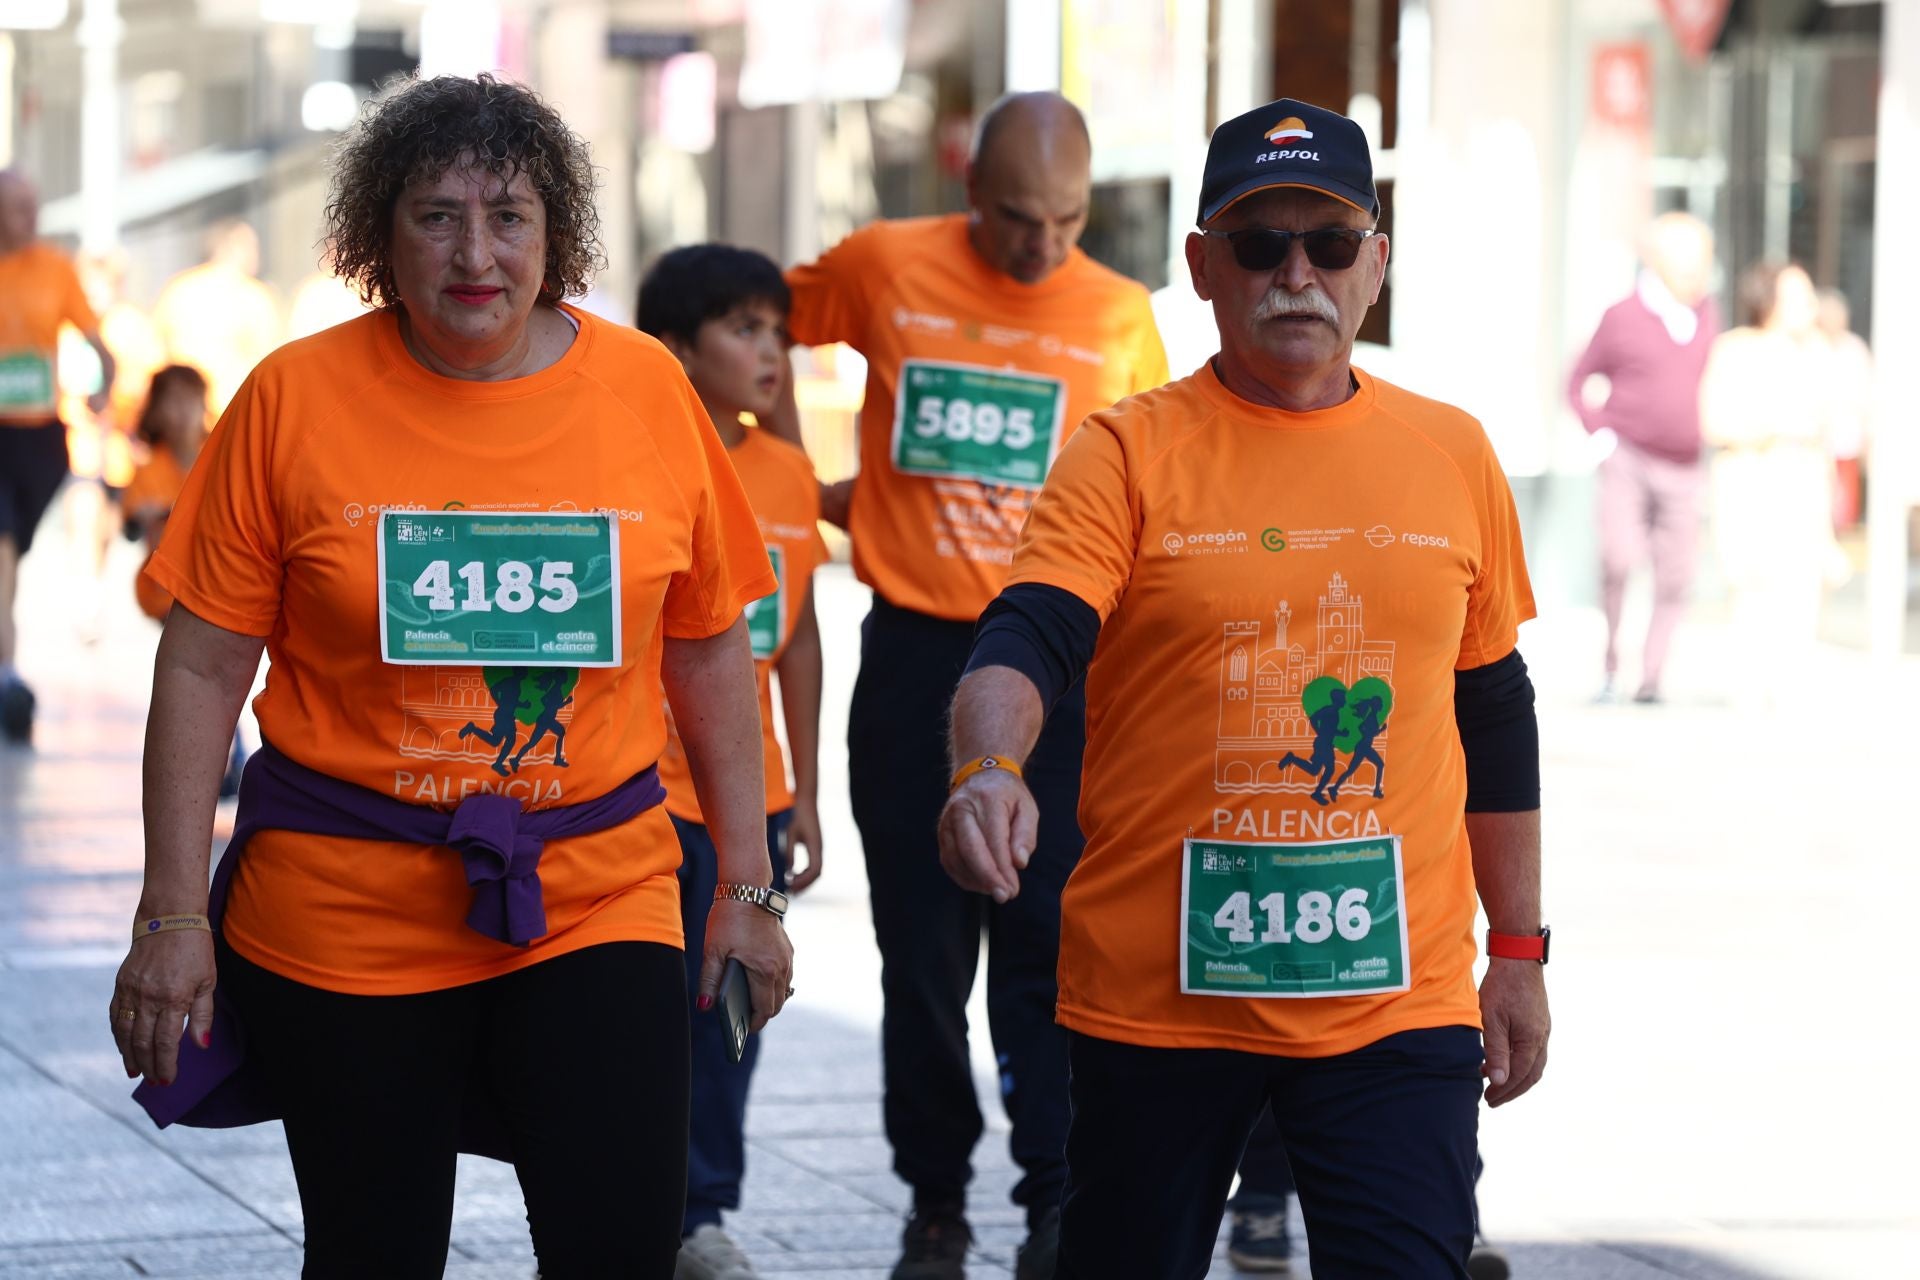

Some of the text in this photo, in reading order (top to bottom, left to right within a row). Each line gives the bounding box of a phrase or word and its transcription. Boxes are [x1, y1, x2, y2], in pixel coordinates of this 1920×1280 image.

[1255, 150, 1320, 164] REPSOL
[914, 396, 1036, 450] 5895
[1188, 529, 1247, 545] oregón
[1401, 532, 1449, 548] repsol
[1188, 545, 1248, 555] comercial
[412, 559, 579, 613] 4185
[404, 630, 449, 640] Palencia
[557, 631, 595, 641] contra
[542, 641, 553, 651] el
[555, 641, 595, 651] cáncer
[394, 770, 563, 803] PALENCIA
[1212, 808, 1382, 838] PALENCIA
[1213, 887, 1372, 944] 4186
[1205, 961, 1249, 972] Palencia
[1353, 958, 1387, 969] contra
[1338, 968, 1388, 980] el cáncer
